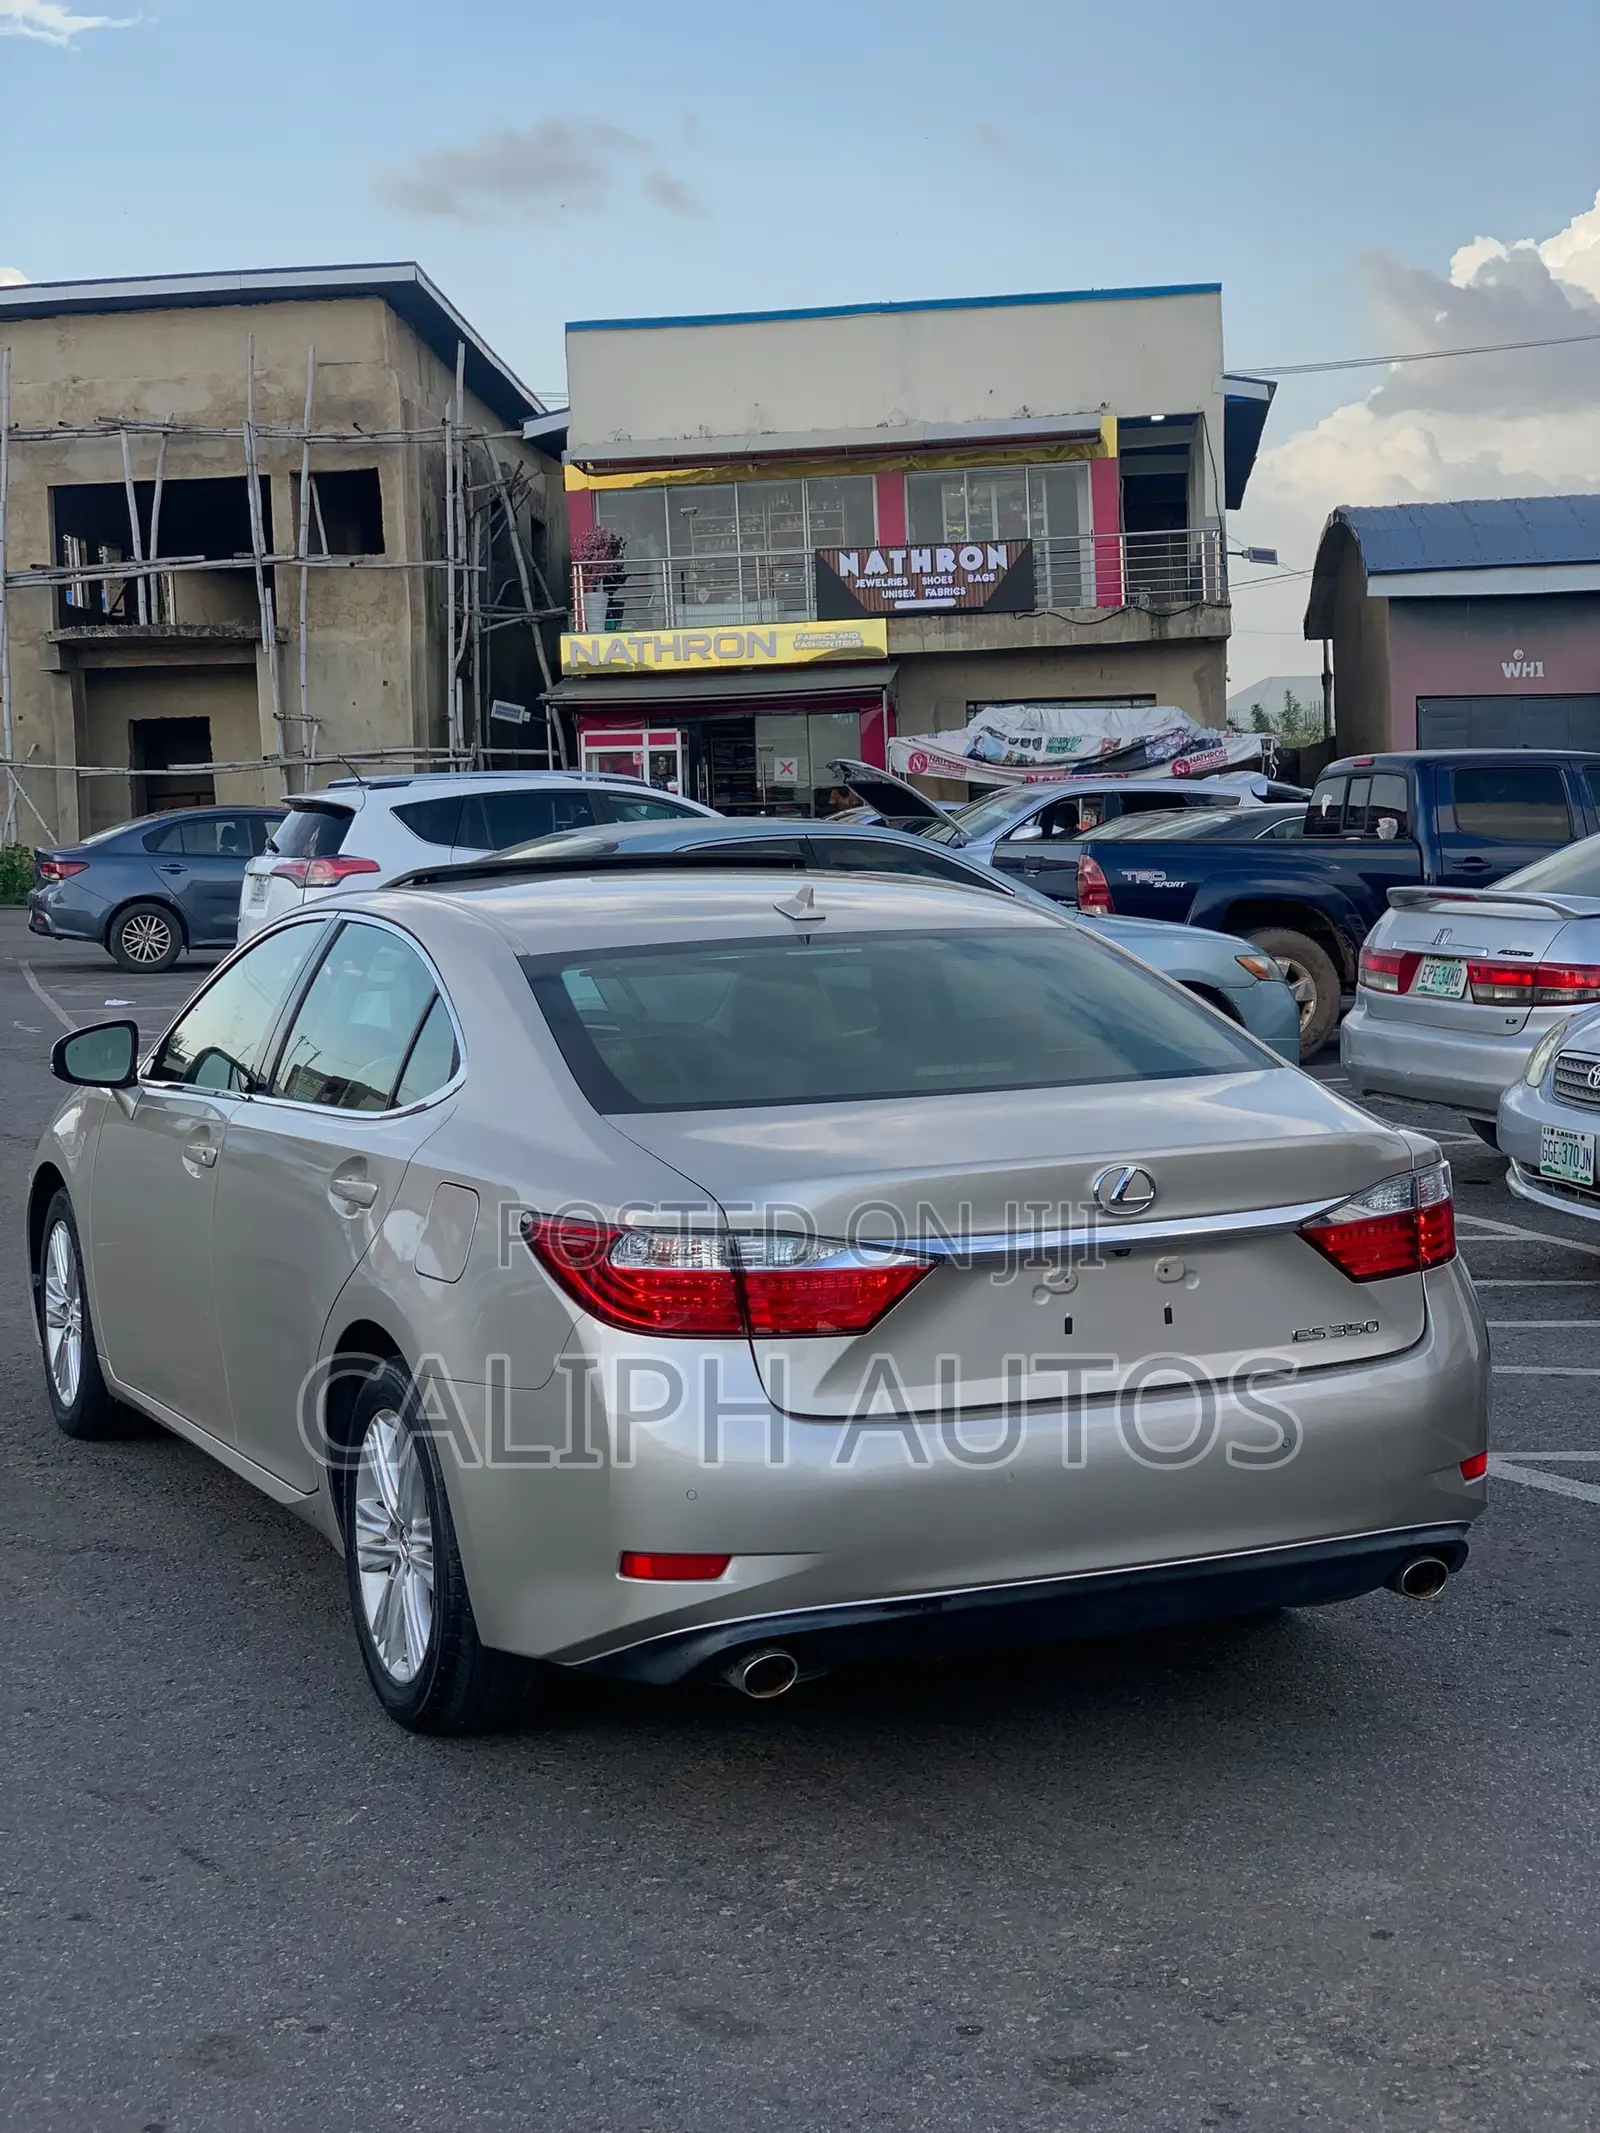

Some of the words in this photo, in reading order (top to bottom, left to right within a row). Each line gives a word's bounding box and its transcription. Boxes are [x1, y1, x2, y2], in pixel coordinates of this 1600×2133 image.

[838, 544, 1009, 577] NATHRON
[855, 577, 909, 588] JEWELRIES
[921, 575, 954, 586] SHOES
[967, 572, 996, 583] BAGS
[882, 589, 916, 599] UNISEX
[925, 586, 967, 597] FABRICS
[796, 632, 837, 641] FABRICS
[838, 631, 859, 640] AND
[569, 631, 777, 668] NATHRON
[794, 640, 834, 649] FASHION
[834, 639, 861, 648] ITEMS
[1189, 748, 1227, 764] NATHRON
[1119, 869, 1167, 884] TRD
[1497, 949, 1534, 958] ACCORD
[1556, 1130, 1578, 1140] LAGOS
[1291, 1327, 1326, 1343] ES
[1329, 1319, 1380, 1339] 350
